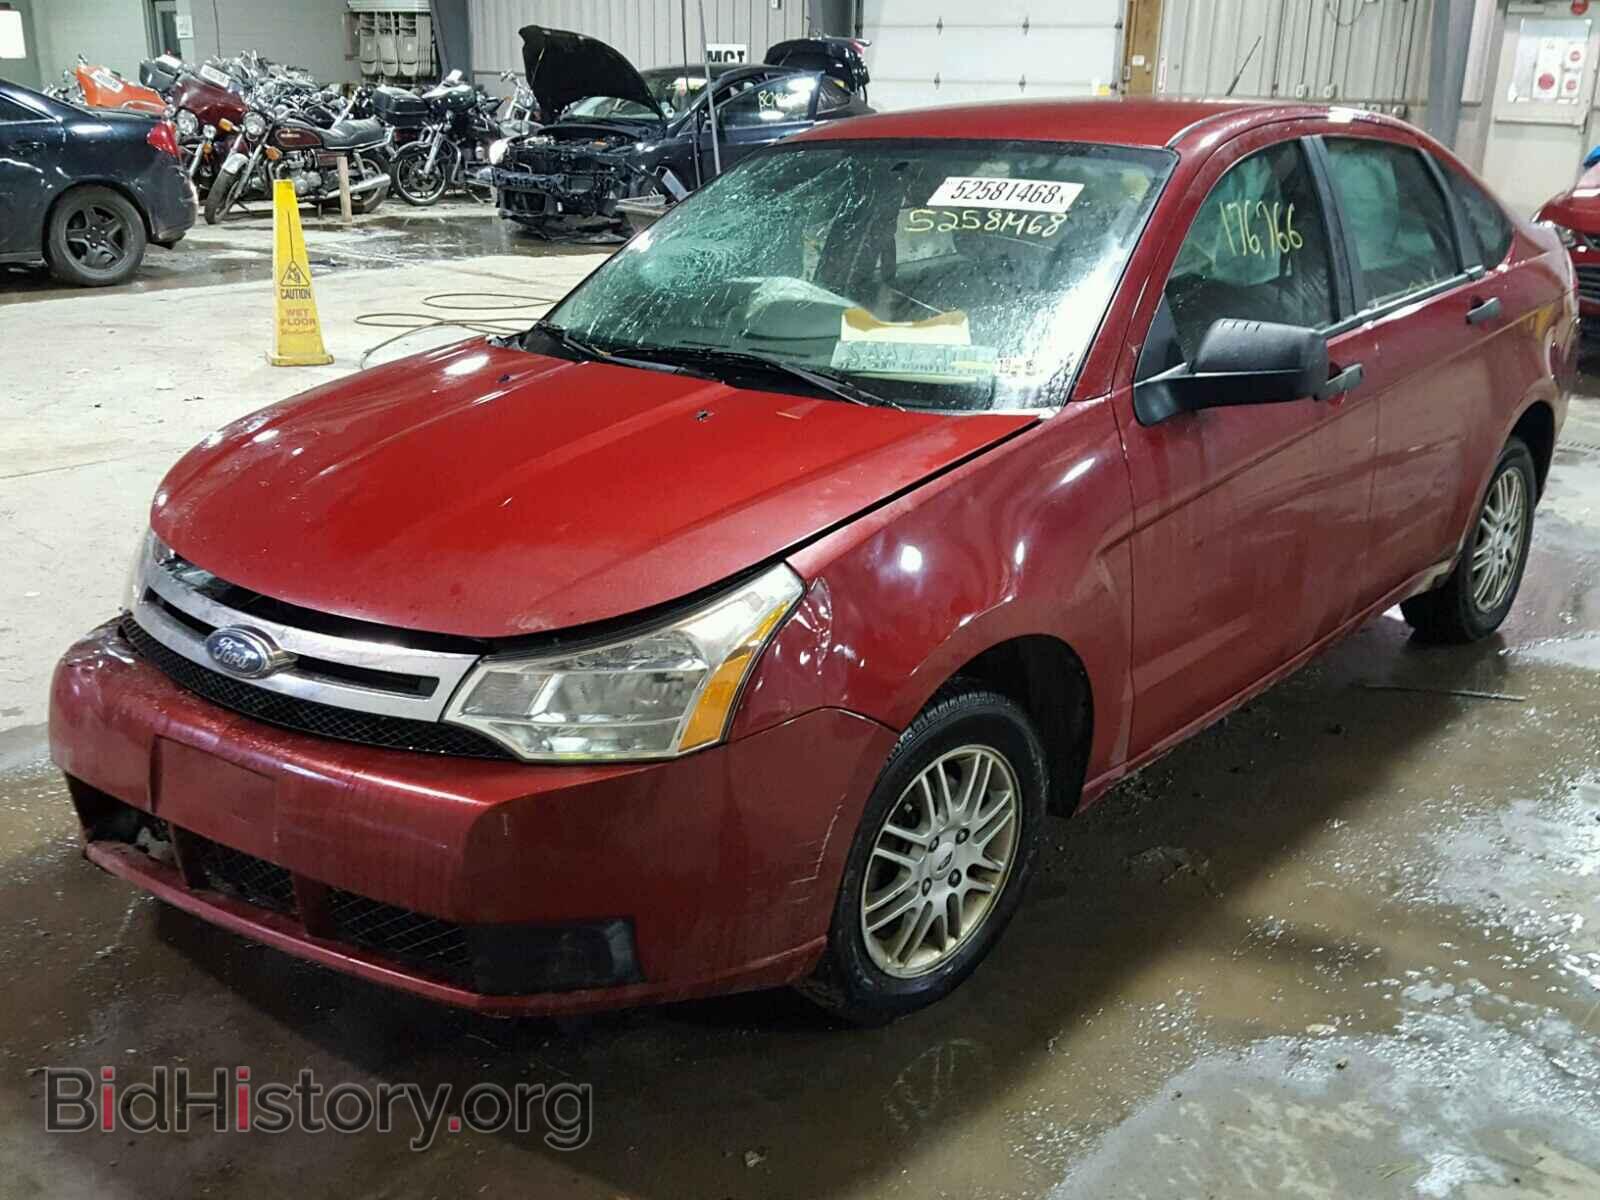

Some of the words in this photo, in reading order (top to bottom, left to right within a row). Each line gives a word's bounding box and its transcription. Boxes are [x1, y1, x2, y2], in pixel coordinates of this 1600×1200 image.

[951, 179, 1061, 204] 52581468
[904, 208, 1067, 237] 52581468
[280, 287, 312, 299] CAUTION
[286, 307, 310, 317] WET
[279, 318, 316, 327] FLOOR
[213, 636, 256, 669] Ford
